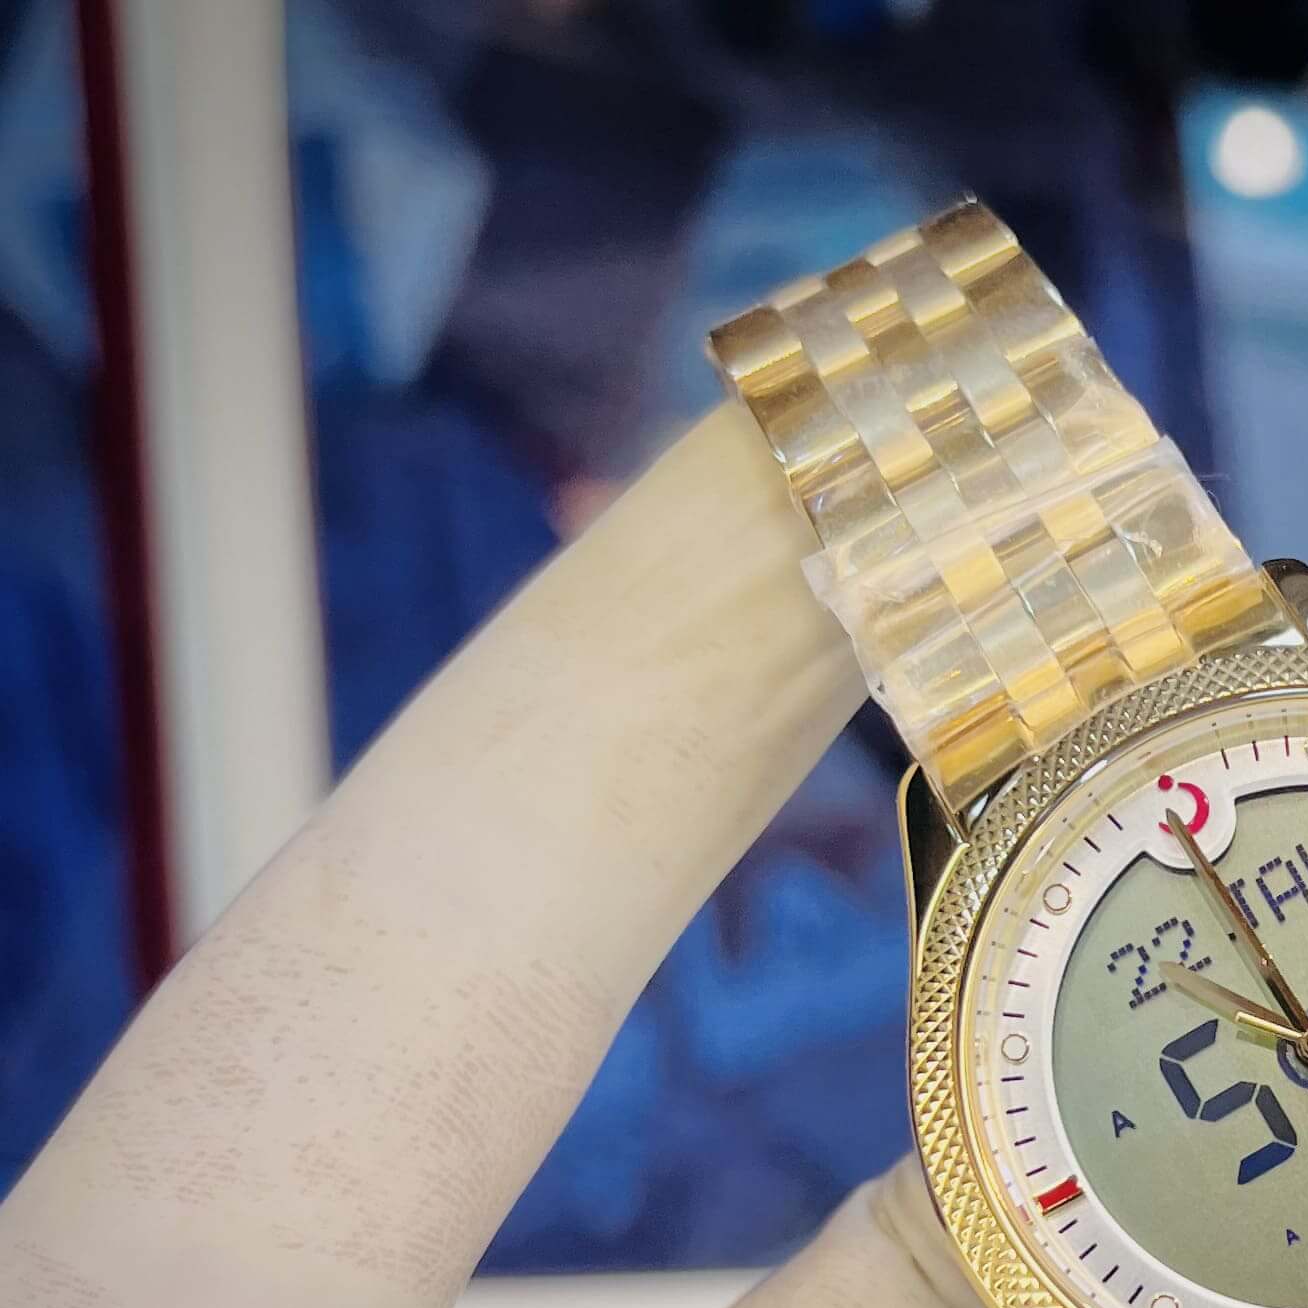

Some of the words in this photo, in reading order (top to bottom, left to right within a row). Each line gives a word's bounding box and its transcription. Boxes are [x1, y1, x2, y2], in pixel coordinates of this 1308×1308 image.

[1106, 917, 1213, 1010] 22
[1111, 1110, 1137, 1139] A
[1159, 1018, 1298, 1186] 5
[1286, 1228, 1301, 1247] A
